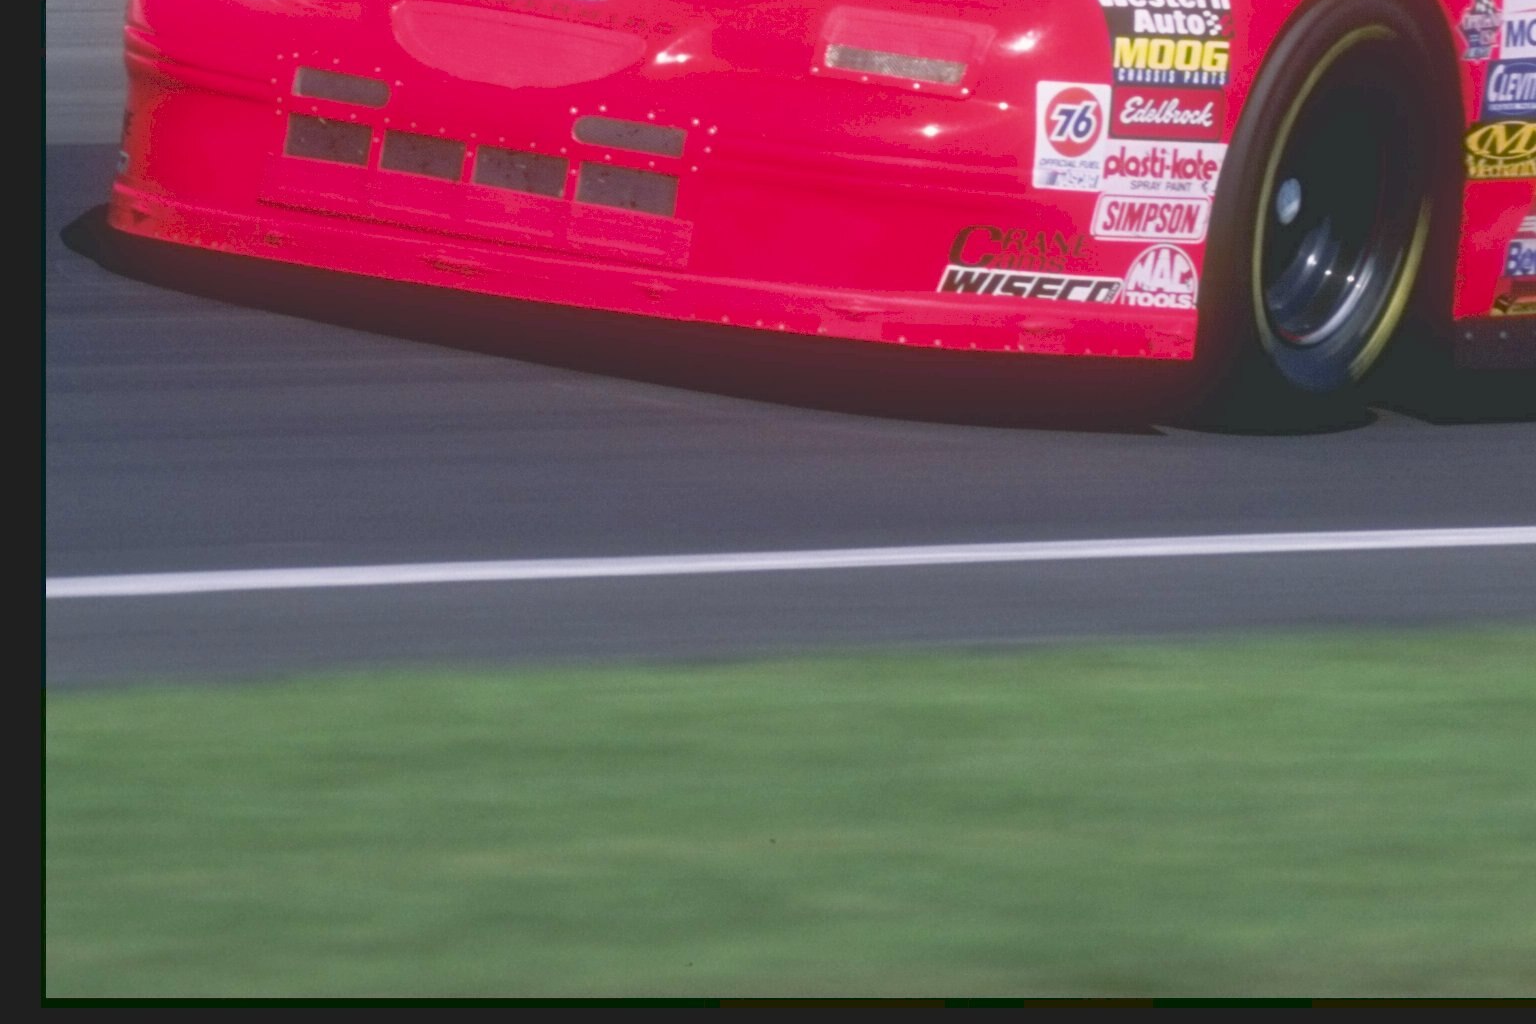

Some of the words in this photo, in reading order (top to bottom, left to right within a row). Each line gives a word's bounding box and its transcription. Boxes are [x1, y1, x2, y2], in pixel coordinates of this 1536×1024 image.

[1134, 9, 1206, 36] Auto
[1113, 37, 1230, 72] MOOG
[1117, 69, 1176, 84] CHASSIS
[1184, 71, 1227, 85] PARTS
[1051, 101, 1097, 142] 76
[1119, 96, 1214, 127] Edelbrock
[1038, 158, 1077, 169] OFFICIAL
[1079, 160, 1101, 170] FUEL
[1103, 146, 1219, 180] plasti-kote
[1130, 180, 1161, 190] SPRAY
[1165, 181, 1192, 191] PAINT
[1102, 201, 1200, 234] SIMPSON
[938, 267, 1113, 303] WISECO
[1127, 248, 1194, 292] MAC
